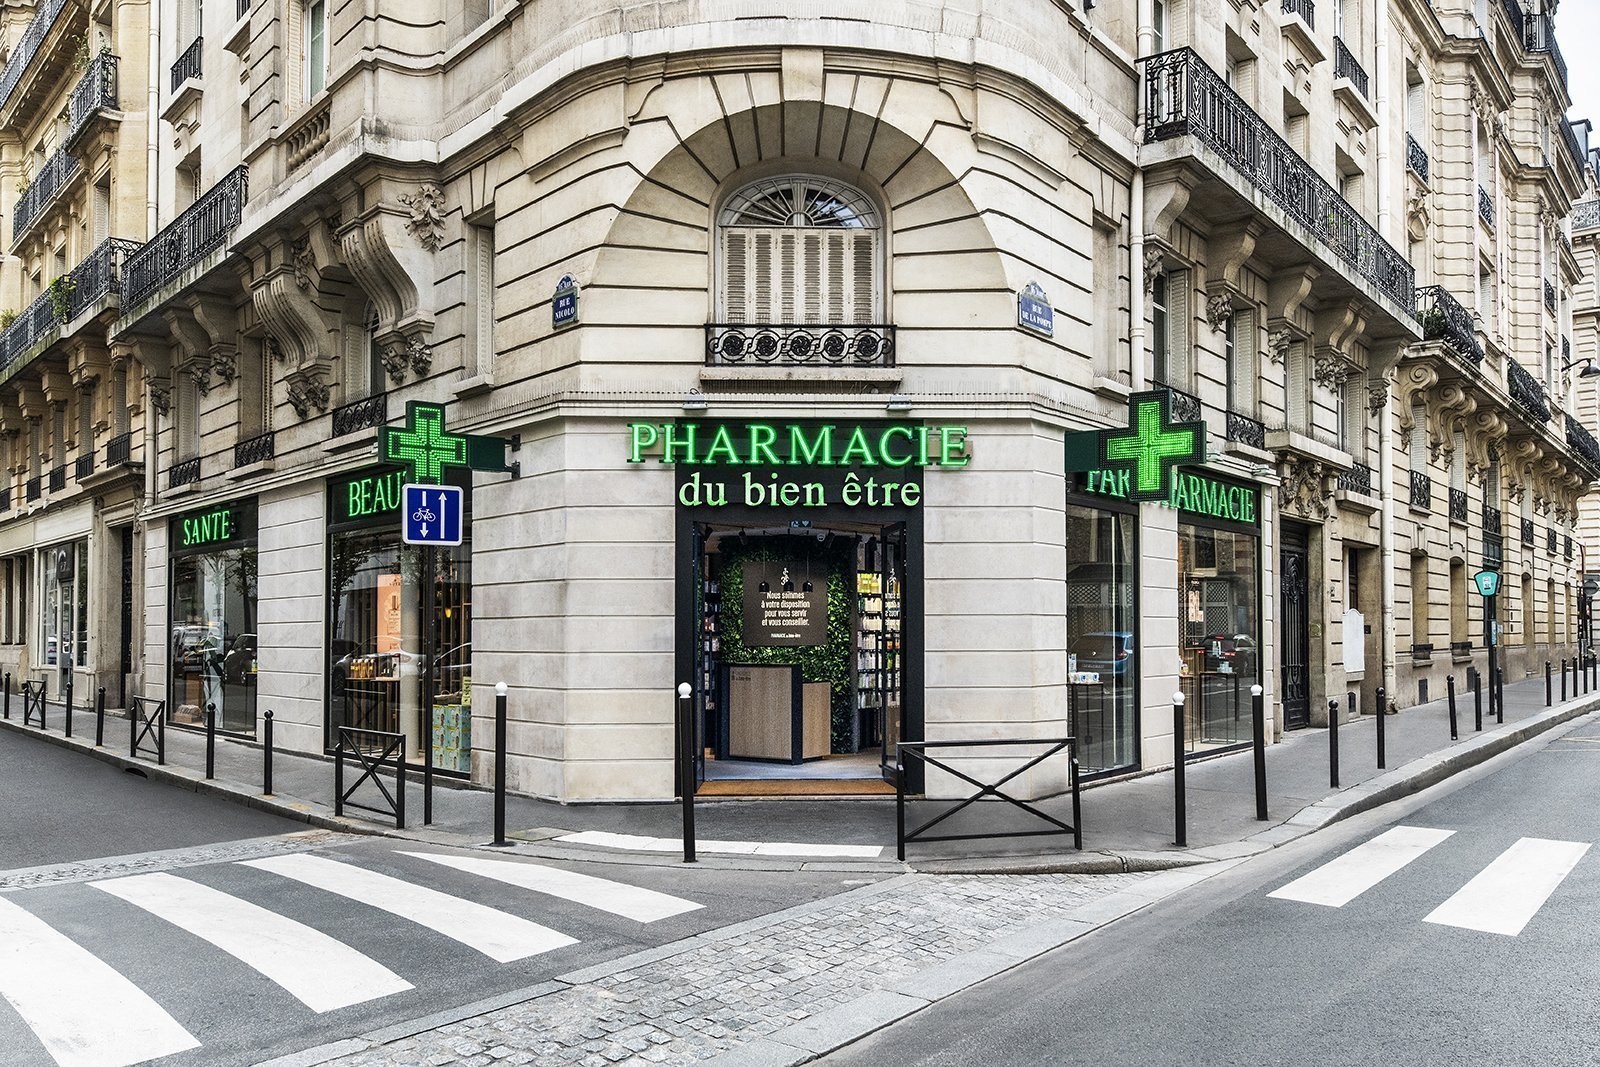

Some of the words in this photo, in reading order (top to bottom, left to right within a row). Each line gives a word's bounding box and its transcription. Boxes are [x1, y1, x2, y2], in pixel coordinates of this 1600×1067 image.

[559, 297, 571, 308] RUE
[555, 306, 575, 321] NICOLO
[1032, 303, 1043, 315] RUE
[1022, 310, 1029, 320] DE
[1029, 313, 1037, 323] LA
[1036, 316, 1052, 329] POMPE
[628, 422, 969, 466] PHARMACIE
[678, 471, 728, 507] du
[742, 471, 828, 507] bien
[841, 472, 921, 507] être
[766, 592, 781, 600] Nous
[782, 592, 805, 600] sommes
[780, 600, 811, 609] disposition
[764, 610, 778, 618] pour
[791, 609, 807, 617] servir
[761, 618, 768, 626] et
[781, 618, 810, 626] conseiller.
